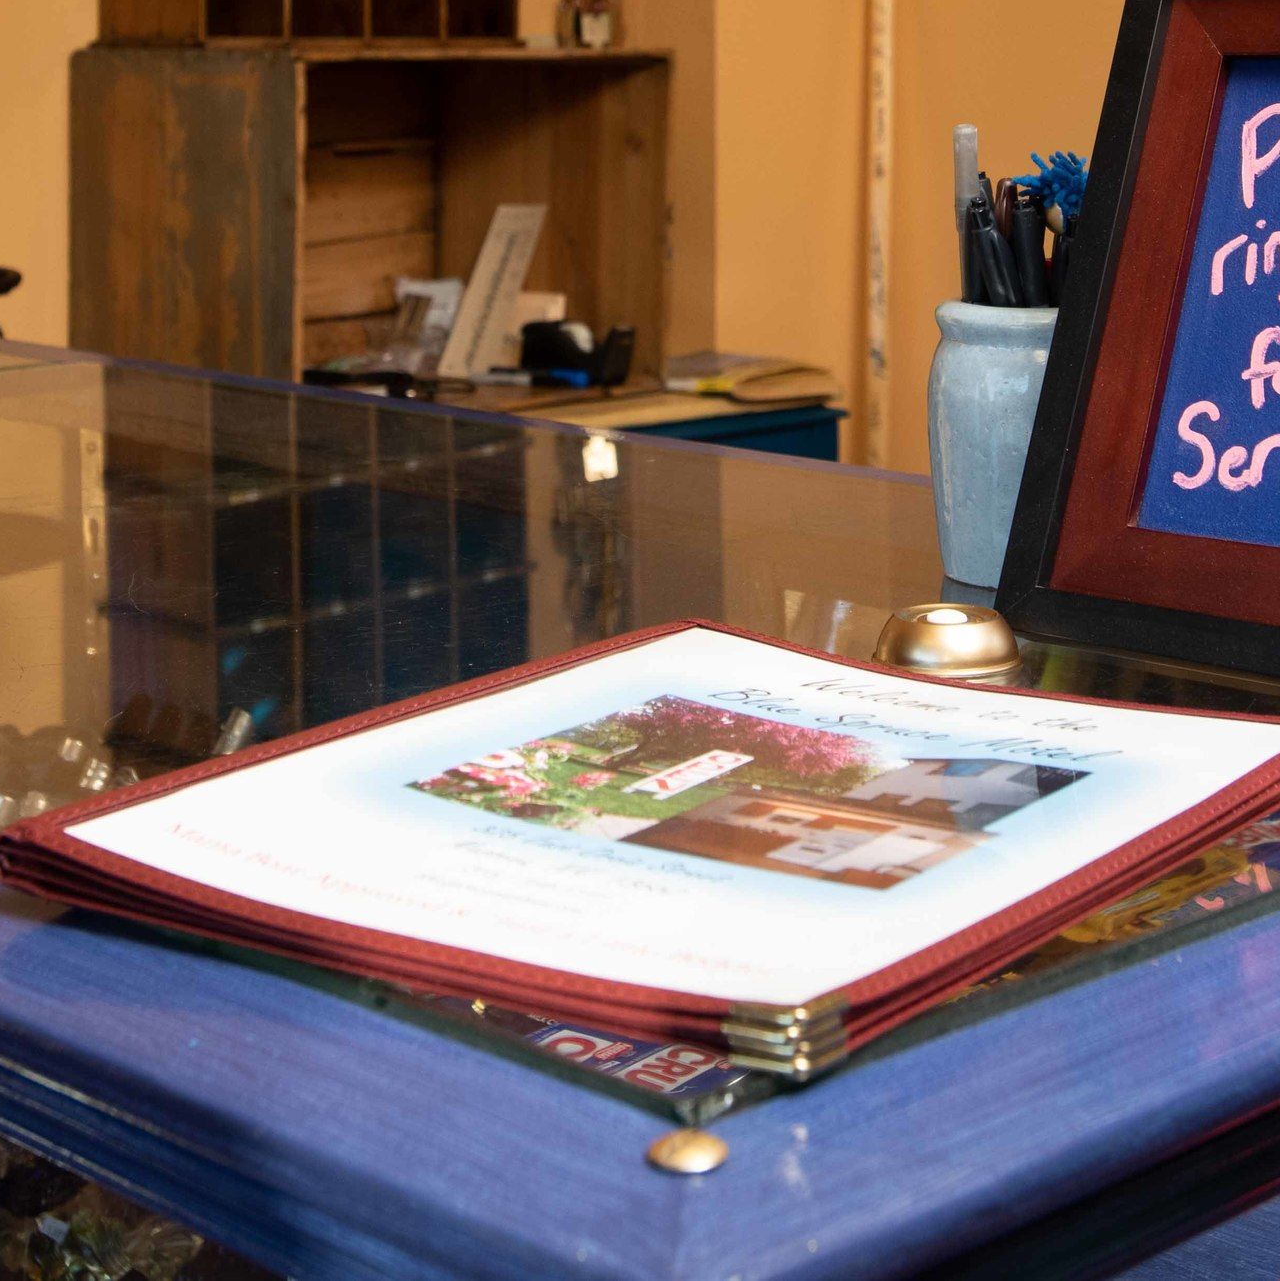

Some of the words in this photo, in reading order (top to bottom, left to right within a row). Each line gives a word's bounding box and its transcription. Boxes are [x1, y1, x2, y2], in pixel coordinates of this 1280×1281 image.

[708, 687, 801, 715] Blue
[814, 713, 951, 741] Spruce
[960, 737, 1124, 762] Motel
[801, 678, 961, 713] Welcome
[978, 710, 1019, 721] to
[1032, 717, 1099, 733] the
